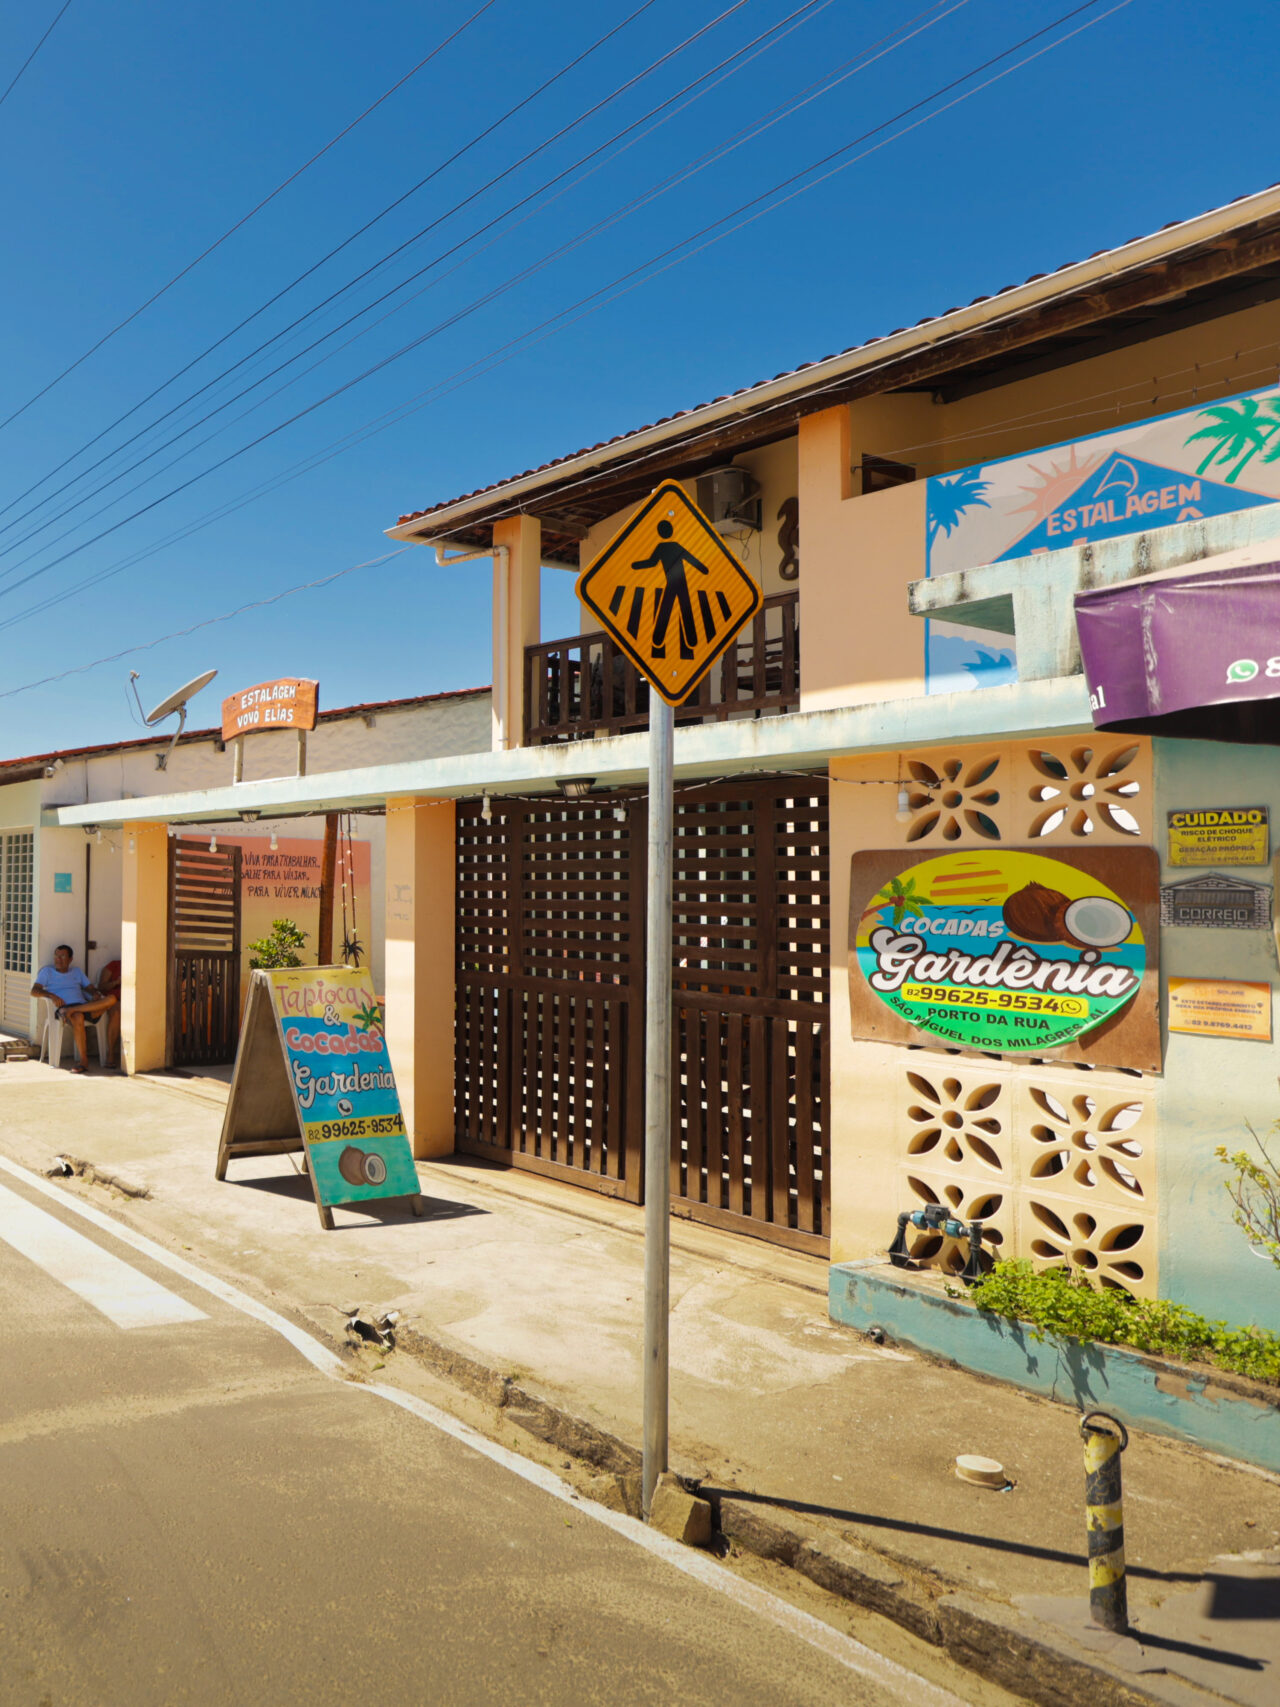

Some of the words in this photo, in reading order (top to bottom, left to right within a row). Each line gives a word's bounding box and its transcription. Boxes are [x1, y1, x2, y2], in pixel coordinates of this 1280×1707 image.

[1047, 480, 1201, 536] ESTALAGEM
[241, 685, 296, 709] ESTALAGEM
[1088, 685, 1106, 711] al
[1172, 809, 1262, 827] CUIDADO
[1219, 828, 1254, 836] CHOQUE
[262, 854, 279, 866] PARA
[1179, 845, 1217, 854] GERAÇÃO
[262, 870, 281, 880] PARA
[248, 885, 269, 897] PARA
[1180, 907, 1248, 921] CORREIO
[899, 917, 1005, 938] COCADAS
[869, 926, 1137, 998] Gardênia
[275, 980, 374, 1018] Tapiocas
[920, 986, 1059, 1013] 99625-9534
[323, 1005, 341, 1027] &
[889, 996, 914, 1017] SÃO
[914, 1014, 966, 1042] MIGUEL
[971, 1036, 1003, 1048] DOS
[1007, 1022, 1081, 1048] MILAGRES
[1090, 1008, 1109, 1020] AL
[928, 1007, 981, 1023] PORTO
[986, 1013, 1008, 1026] DA
[1014, 1015, 1050, 1030] RUA
[292, 1059, 396, 1109] Gardenia
[308, 1129, 320, 1141] 82
[322, 1113, 403, 1139] 99625-9534
